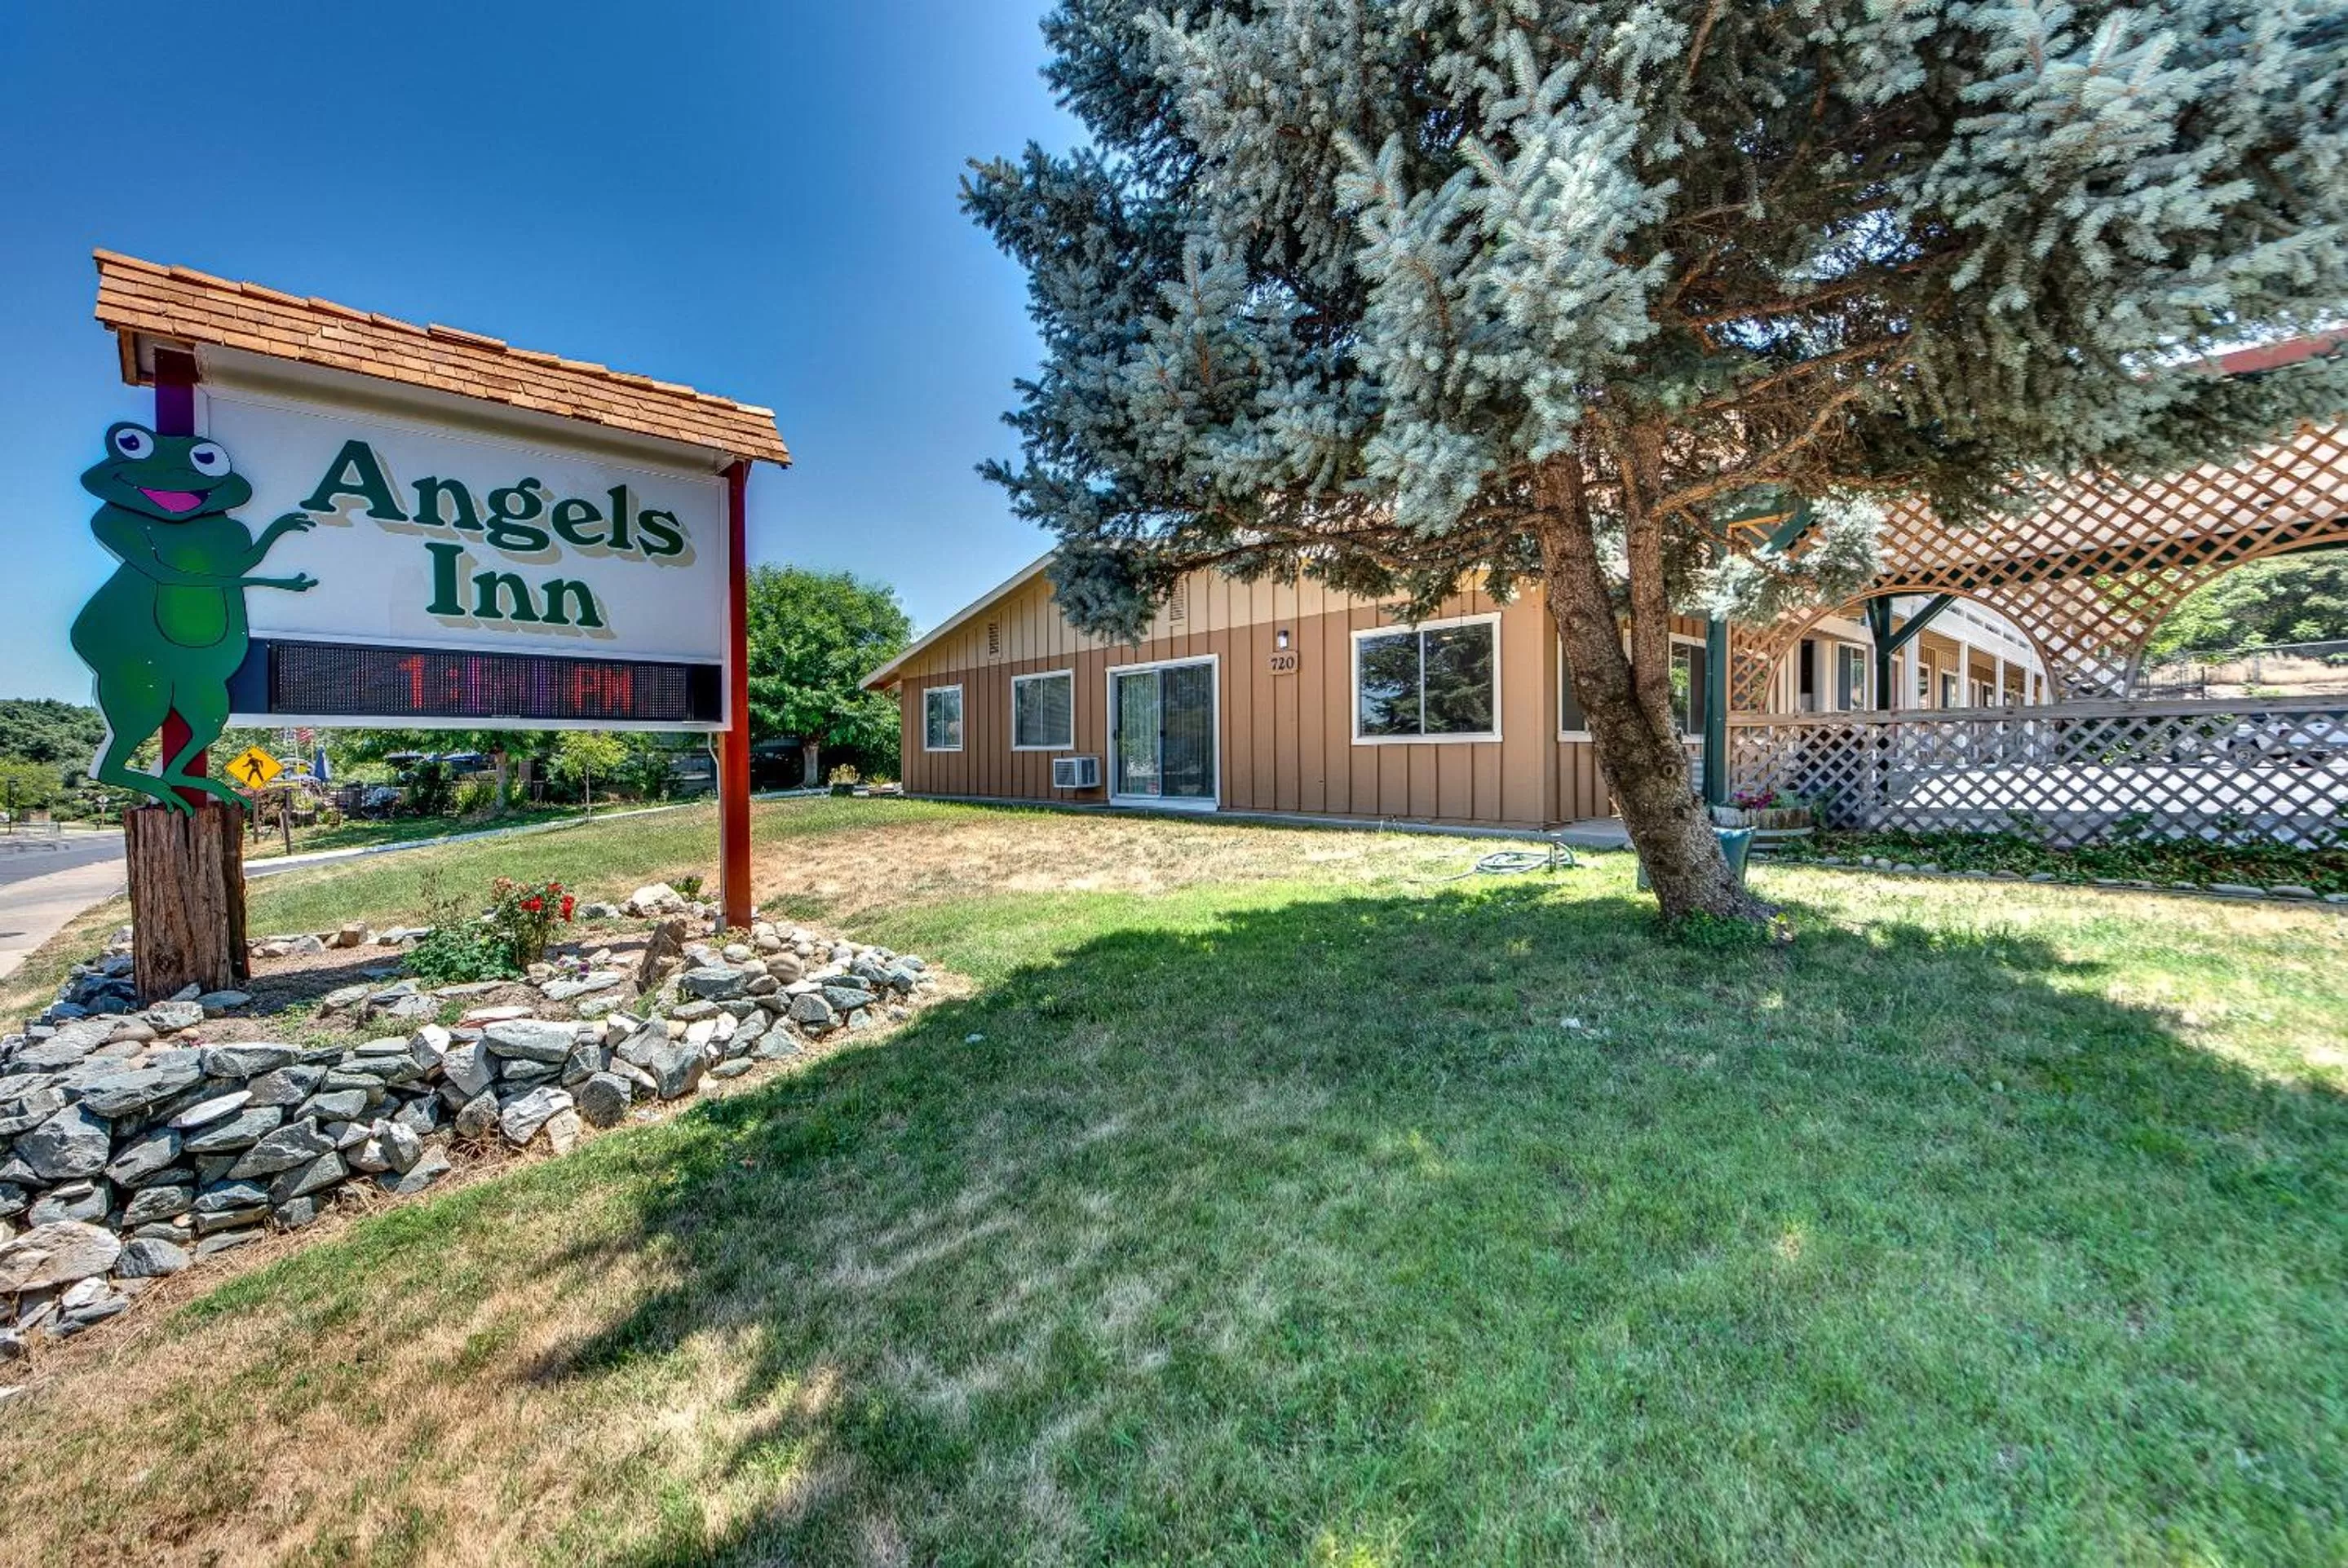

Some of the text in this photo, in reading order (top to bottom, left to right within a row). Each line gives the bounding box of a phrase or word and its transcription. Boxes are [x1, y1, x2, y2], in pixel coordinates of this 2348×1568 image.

[299, 439, 686, 557] Angels
[424, 542, 604, 628] Inn
[573, 662, 633, 712] PM
[1271, 656, 1295, 670] 720
